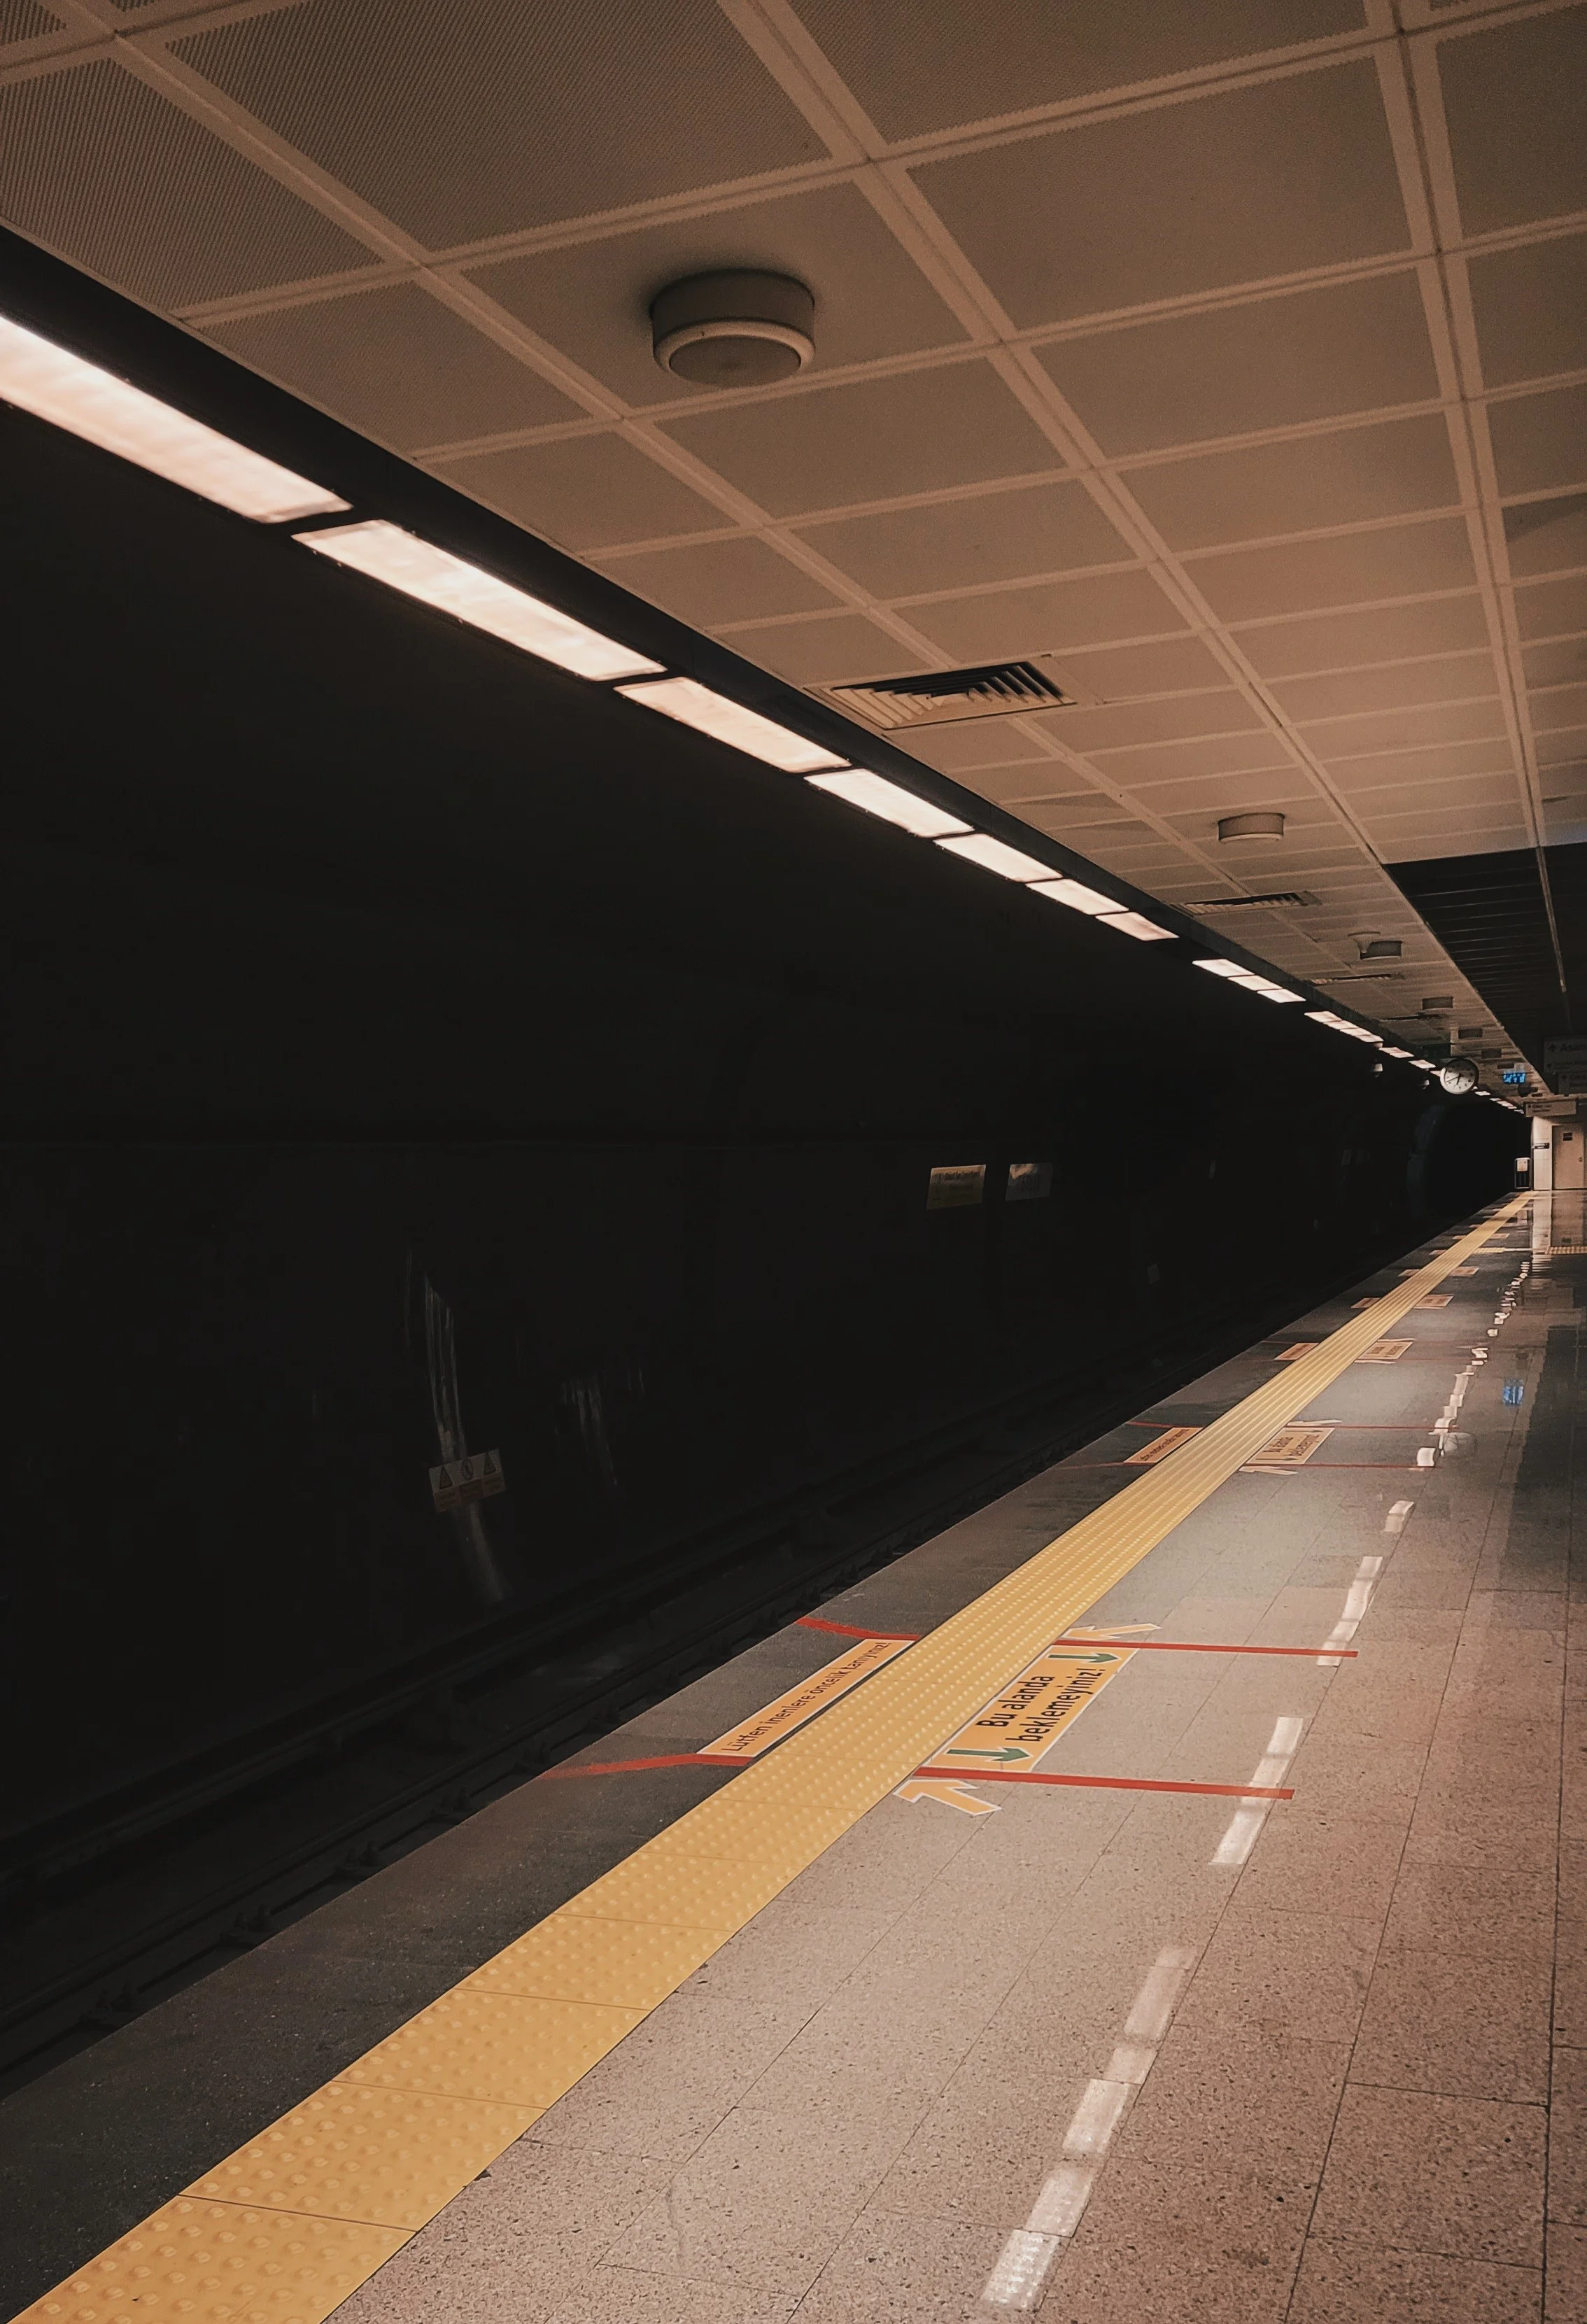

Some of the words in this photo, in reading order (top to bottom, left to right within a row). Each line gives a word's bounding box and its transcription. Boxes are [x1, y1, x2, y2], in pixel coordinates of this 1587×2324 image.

[721, 1725, 773, 1752] Lütfen
[760, 1694, 816, 1727] inenlere
[804, 1667, 849, 1694] öncelik
[975, 1713, 1017, 1727] Bu
[997, 1676, 1055, 1710] alanda
[1005, 1668, 1106, 1742] beklemeyiniz!
